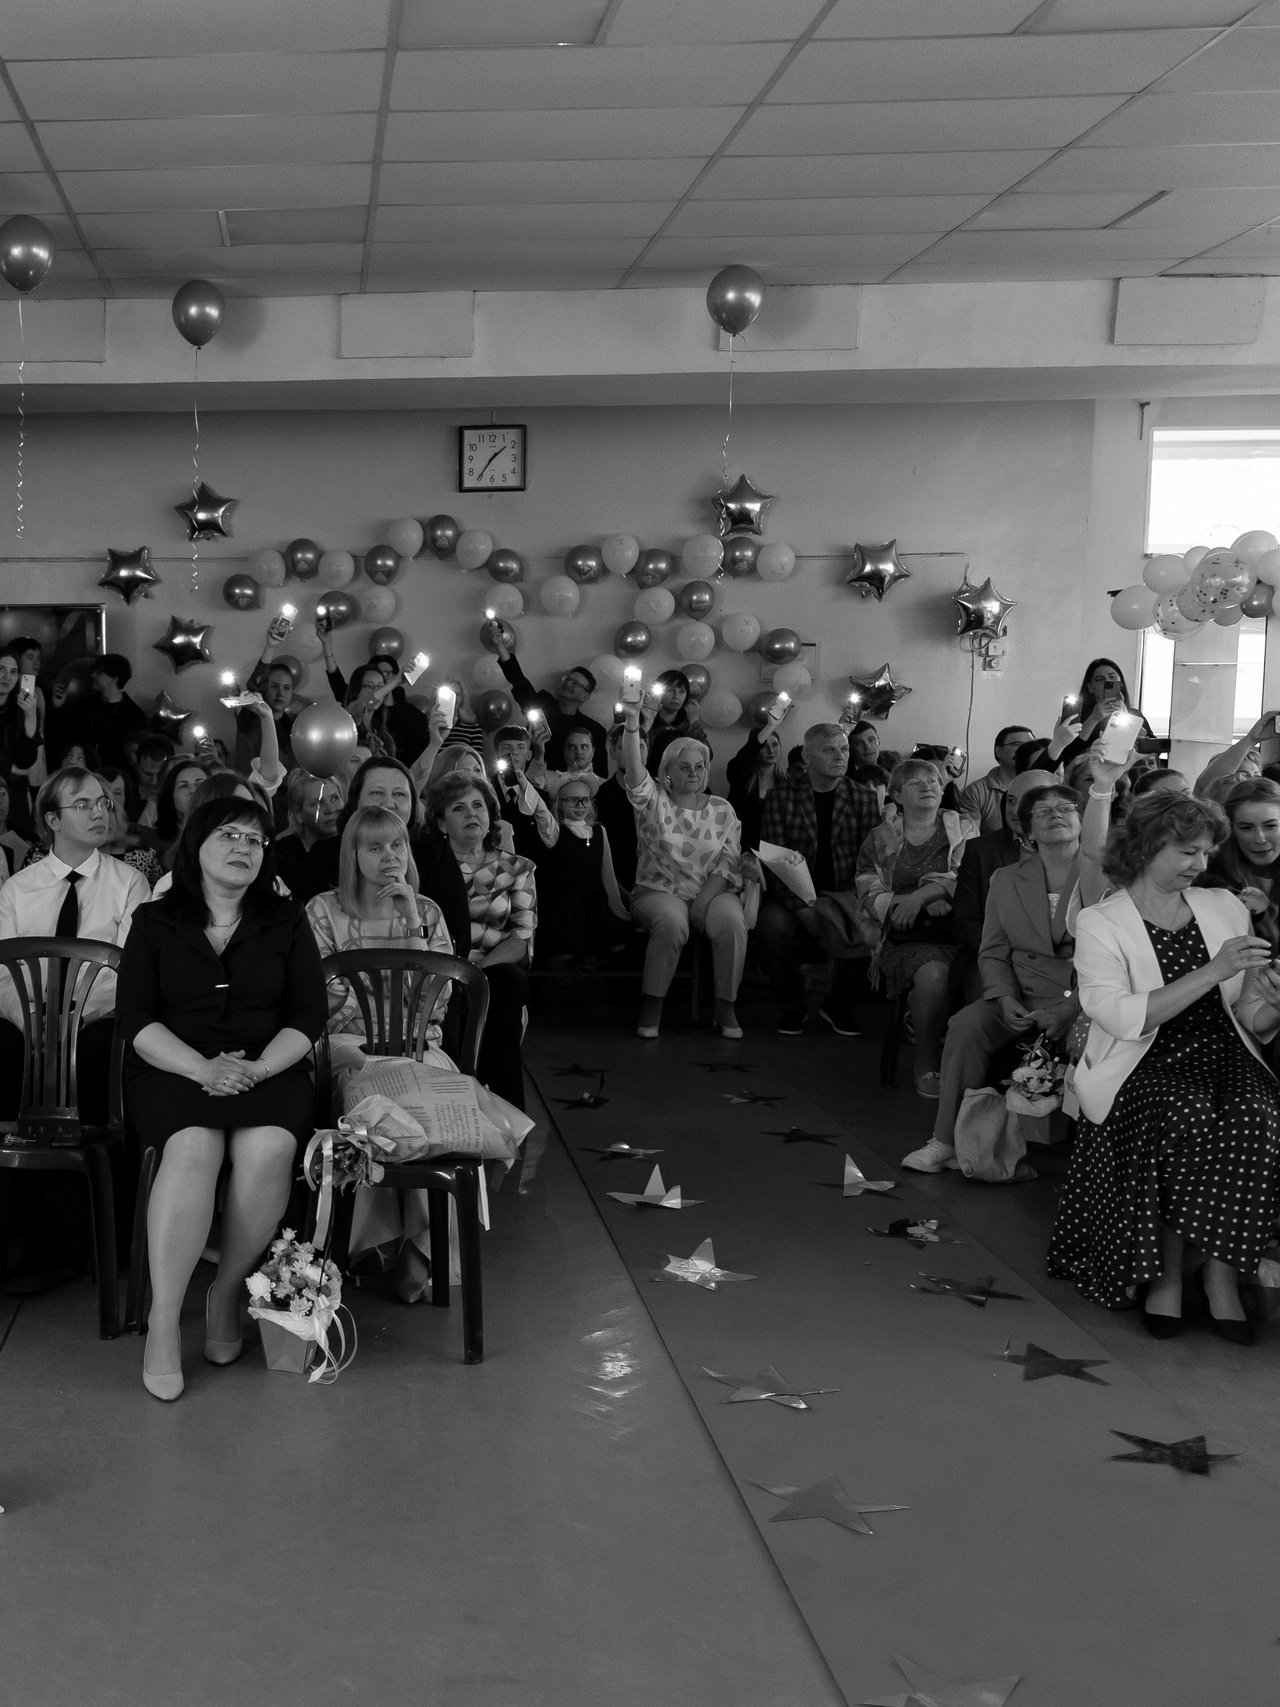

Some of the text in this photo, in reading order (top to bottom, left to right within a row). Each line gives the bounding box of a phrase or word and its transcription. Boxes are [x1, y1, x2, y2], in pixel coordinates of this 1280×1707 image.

[478, 435, 484, 443] 11
[488, 434, 496, 443] 12
[469, 443, 477, 452] 10
[510, 440, 516, 448] 2
[468, 455, 474, 463] 9
[511, 454, 517, 462] 3
[468, 468, 474, 476] 8
[489, 475, 495, 483] 6
[501, 474, 507, 482] 5
